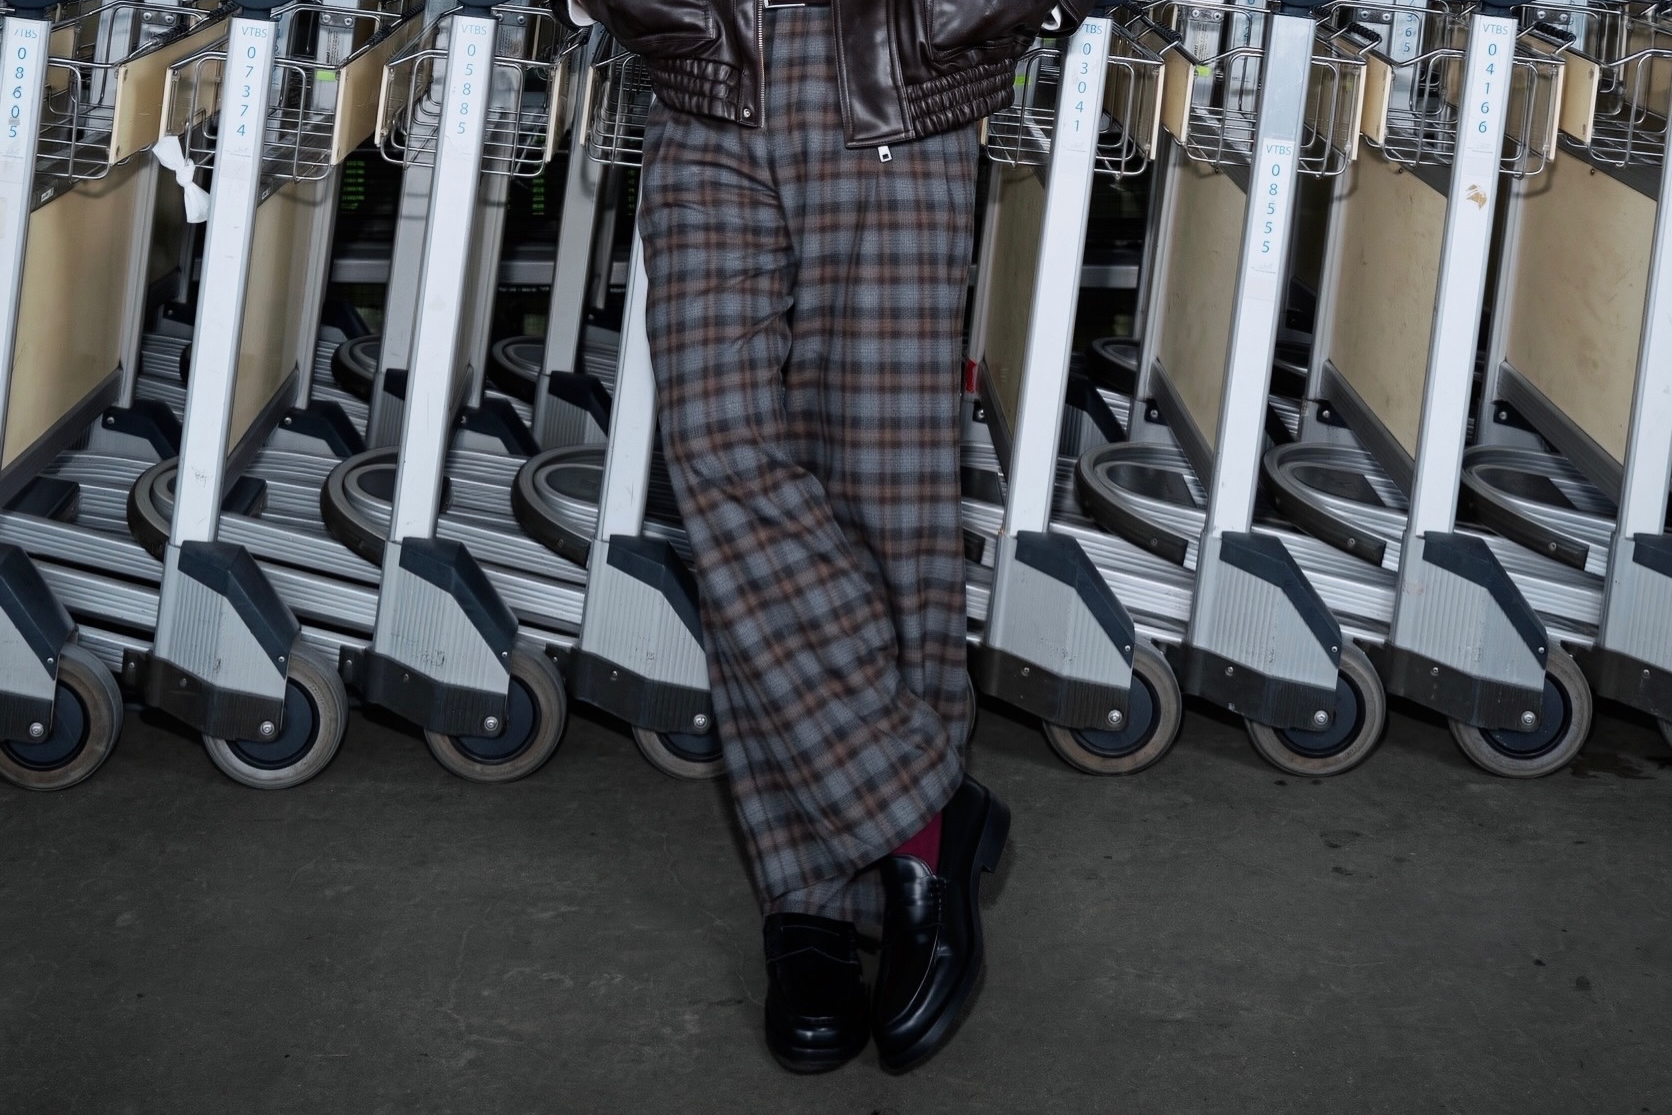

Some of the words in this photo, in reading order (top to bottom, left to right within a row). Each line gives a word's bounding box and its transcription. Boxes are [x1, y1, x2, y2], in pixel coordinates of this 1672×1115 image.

[241, 26, 268, 38] VTBS
[461, 24, 487, 35] VTBS
[1080, 23, 1103, 35] TBS
[1482, 23, 1509, 35] VTBS
[8, 47, 27, 138] 08605
[236, 46, 256, 137] 07374
[457, 43, 477, 134] 05885
[1074, 42, 1092, 132] 03041
[1478, 43, 1498, 134] 04166
[1266, 145, 1292, 156] VTBS
[1261, 164, 1281, 253] 08555
